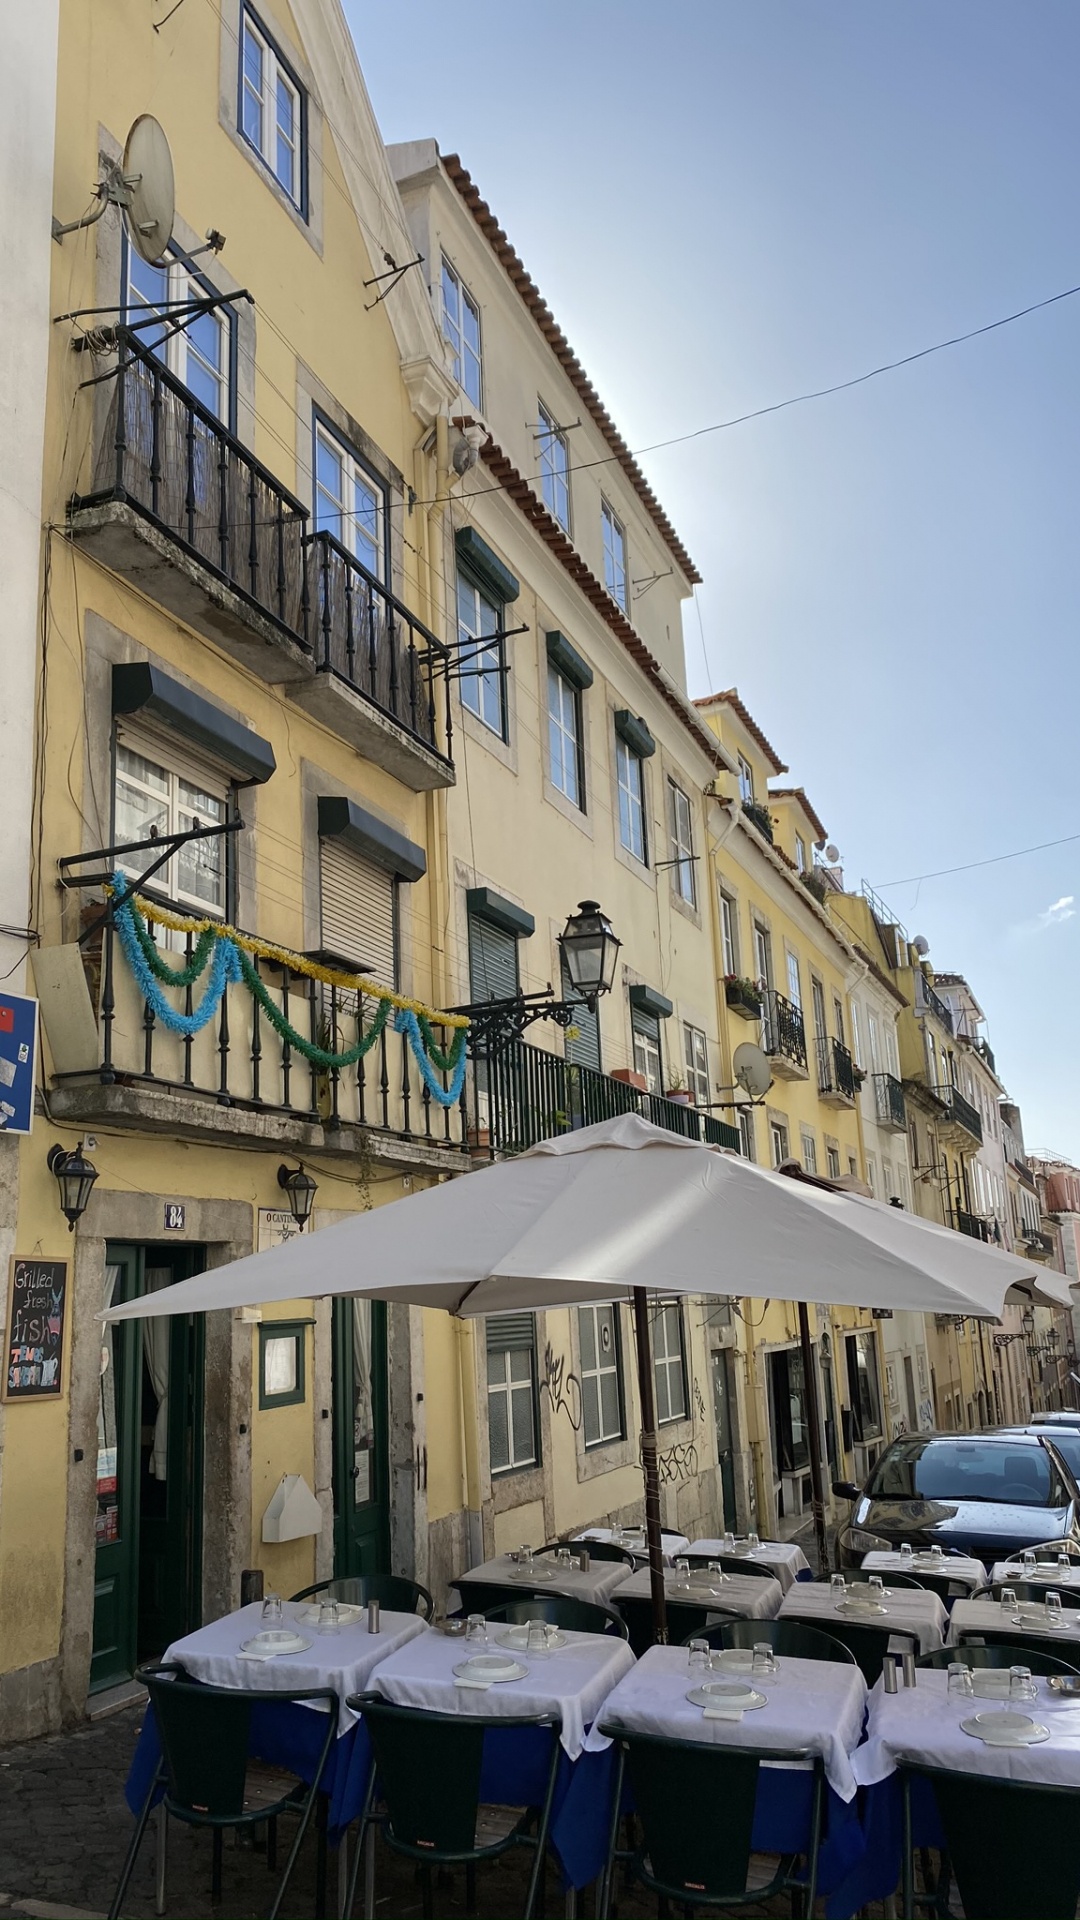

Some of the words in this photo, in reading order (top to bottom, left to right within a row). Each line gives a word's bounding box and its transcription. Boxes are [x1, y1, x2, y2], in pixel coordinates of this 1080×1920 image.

[170, 1206, 183, 1228] 84
[266, 1212, 272, 1223] O
[14, 1262, 55, 1289] Grilled
[22, 1289, 53, 1309] fresh
[11, 1309, 51, 1345] fish
